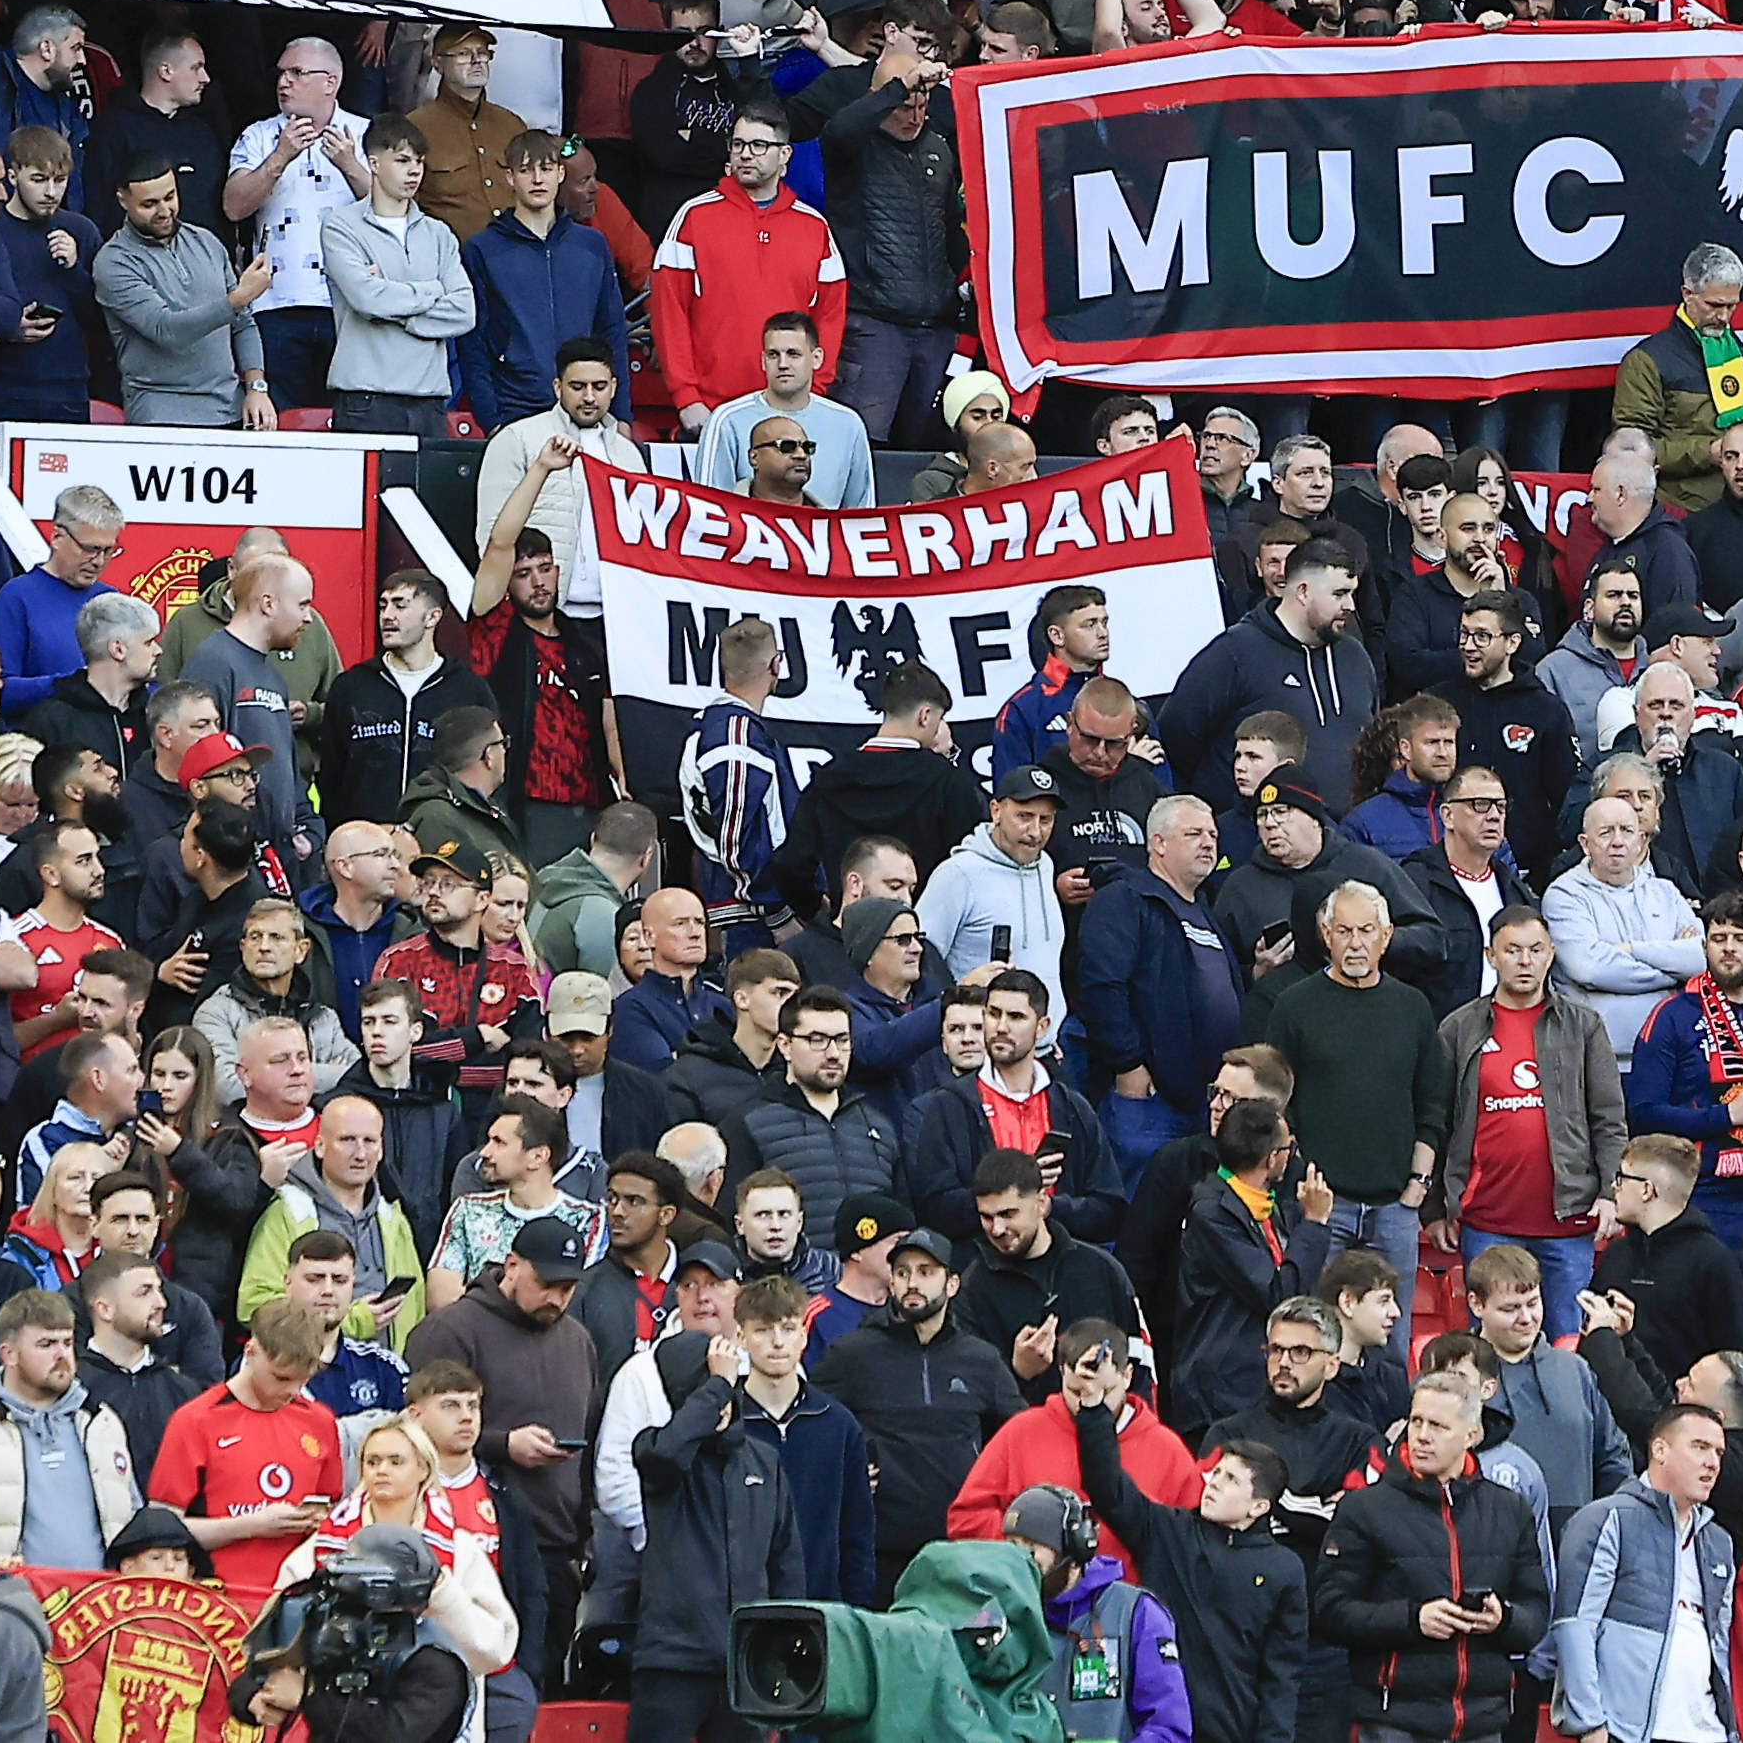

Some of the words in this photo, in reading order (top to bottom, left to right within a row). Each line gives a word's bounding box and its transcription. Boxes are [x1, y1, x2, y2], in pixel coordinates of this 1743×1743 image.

[1072, 135, 1626, 301] MUFC
[129, 463, 258, 506] W104
[608, 468, 1175, 579] WEAVERHAM
[1484, 1092, 1544, 1114] Snapdr
